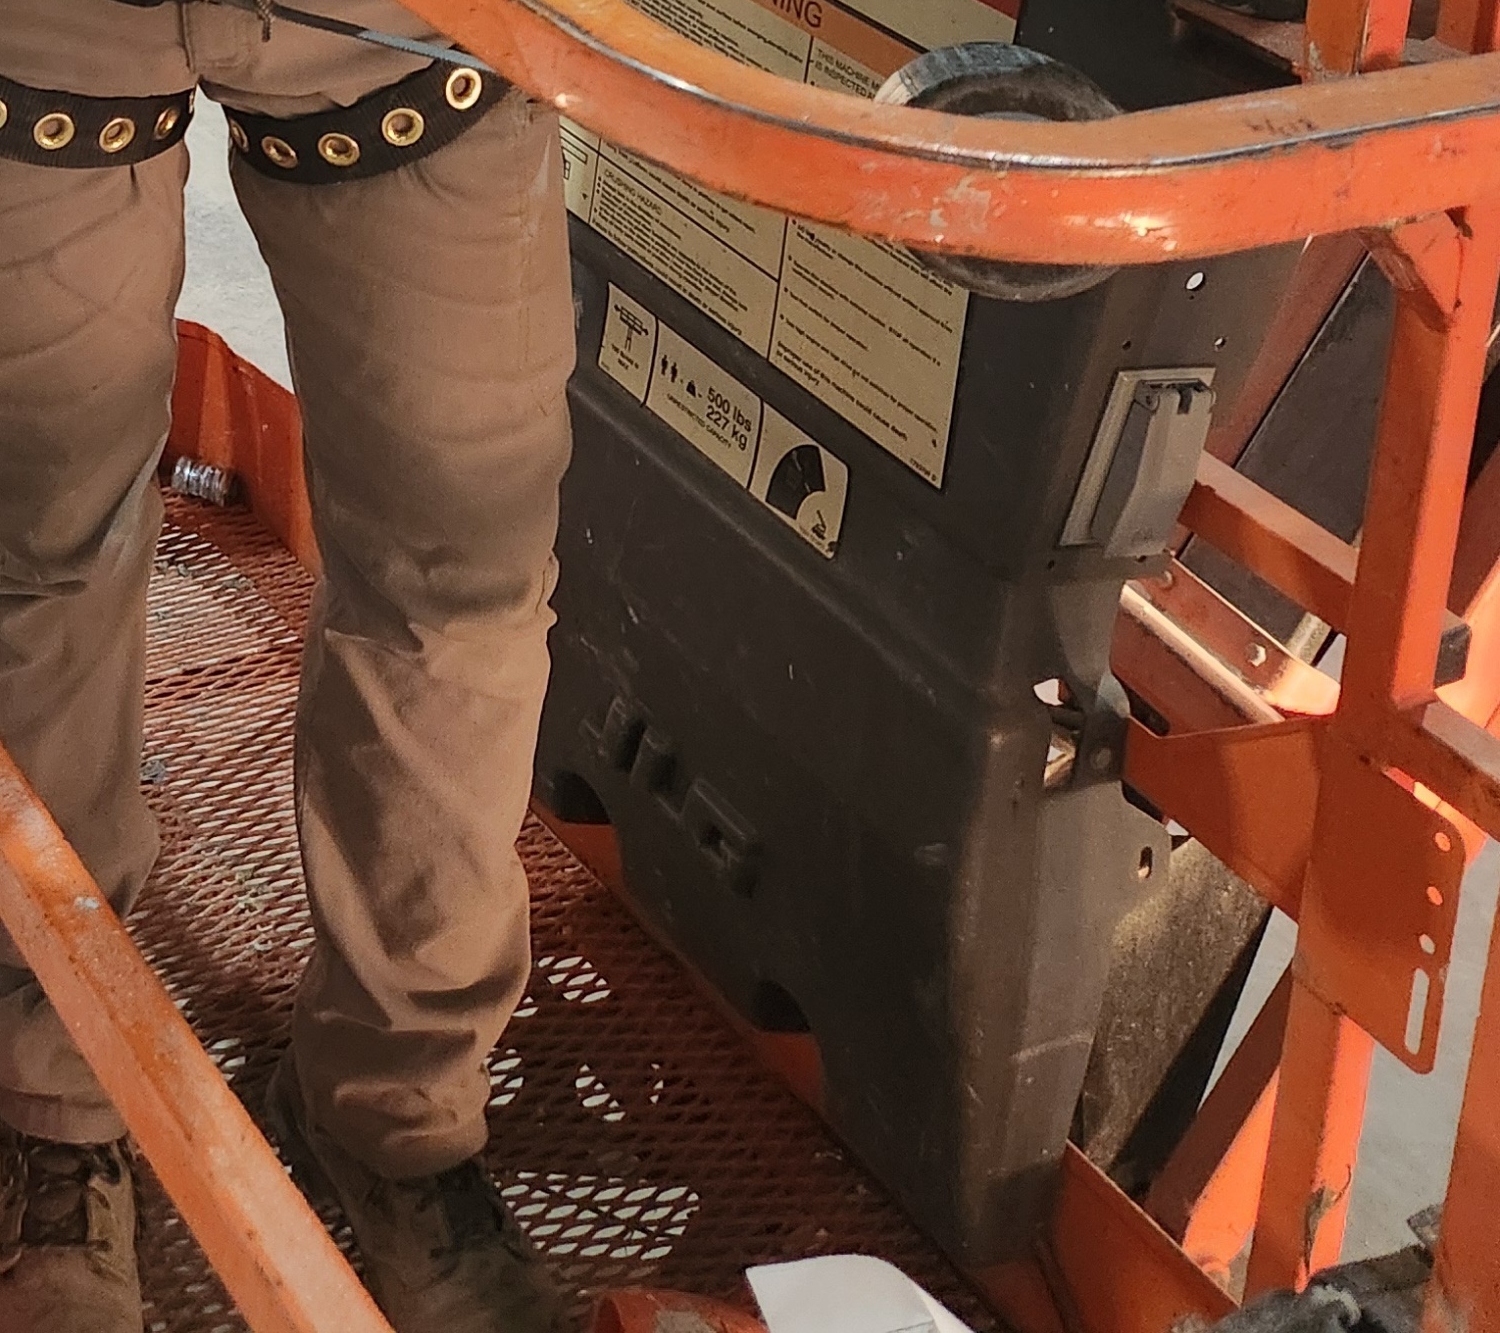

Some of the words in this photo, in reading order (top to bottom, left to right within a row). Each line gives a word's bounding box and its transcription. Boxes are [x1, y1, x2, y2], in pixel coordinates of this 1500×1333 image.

[705, 404, 729, 431] 227
[730, 423, 748, 452] kg
[706, 385, 731, 416] 500
[732, 403, 752, 433] lbs
